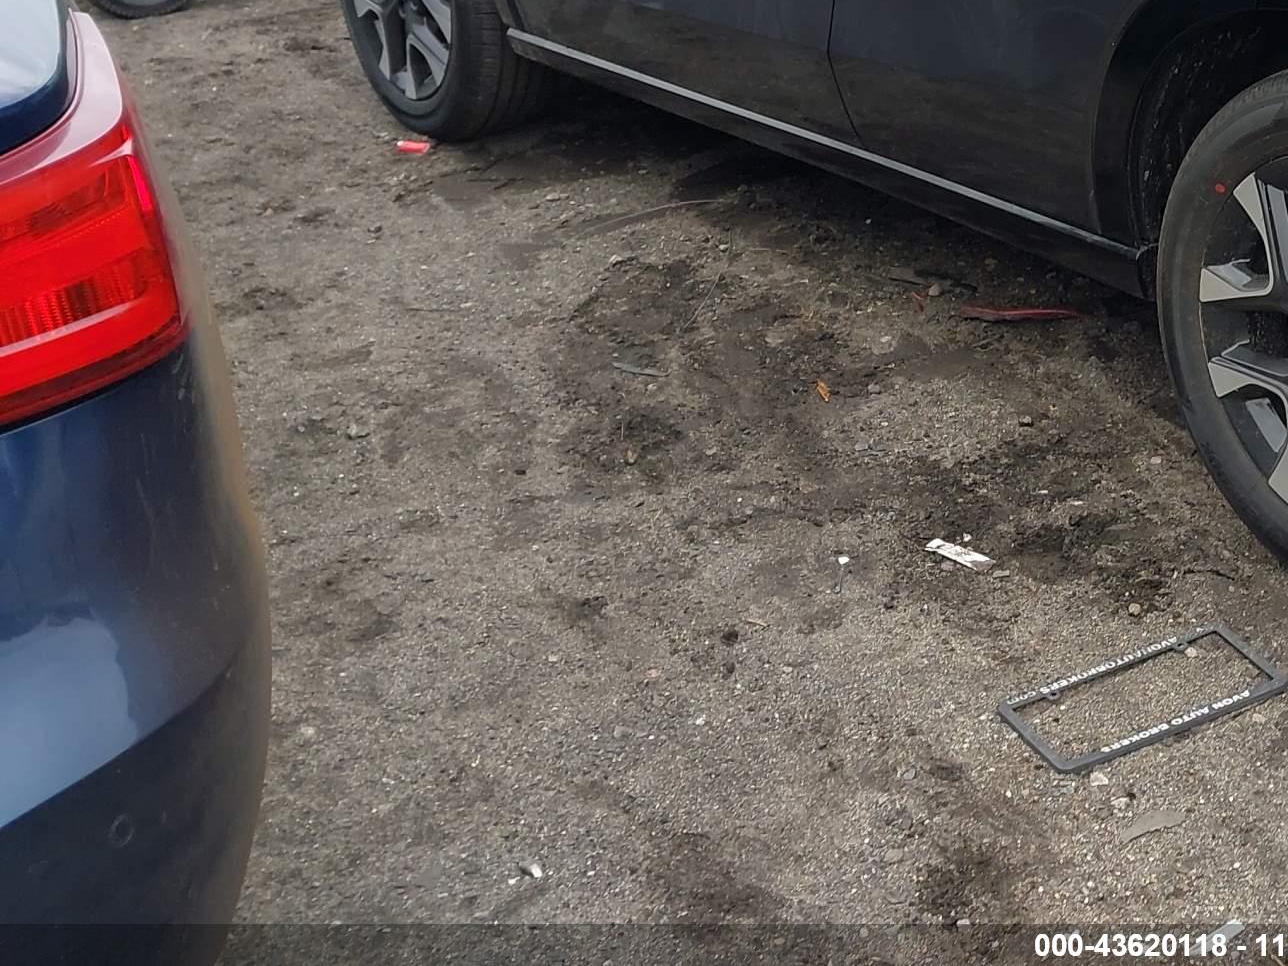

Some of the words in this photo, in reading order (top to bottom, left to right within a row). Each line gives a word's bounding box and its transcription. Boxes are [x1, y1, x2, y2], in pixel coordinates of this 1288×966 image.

[1212, 690, 1250, 710] AVON
[1171, 706, 1209, 726] AUTO
[1100, 723, 1170, 753] BROKERS
